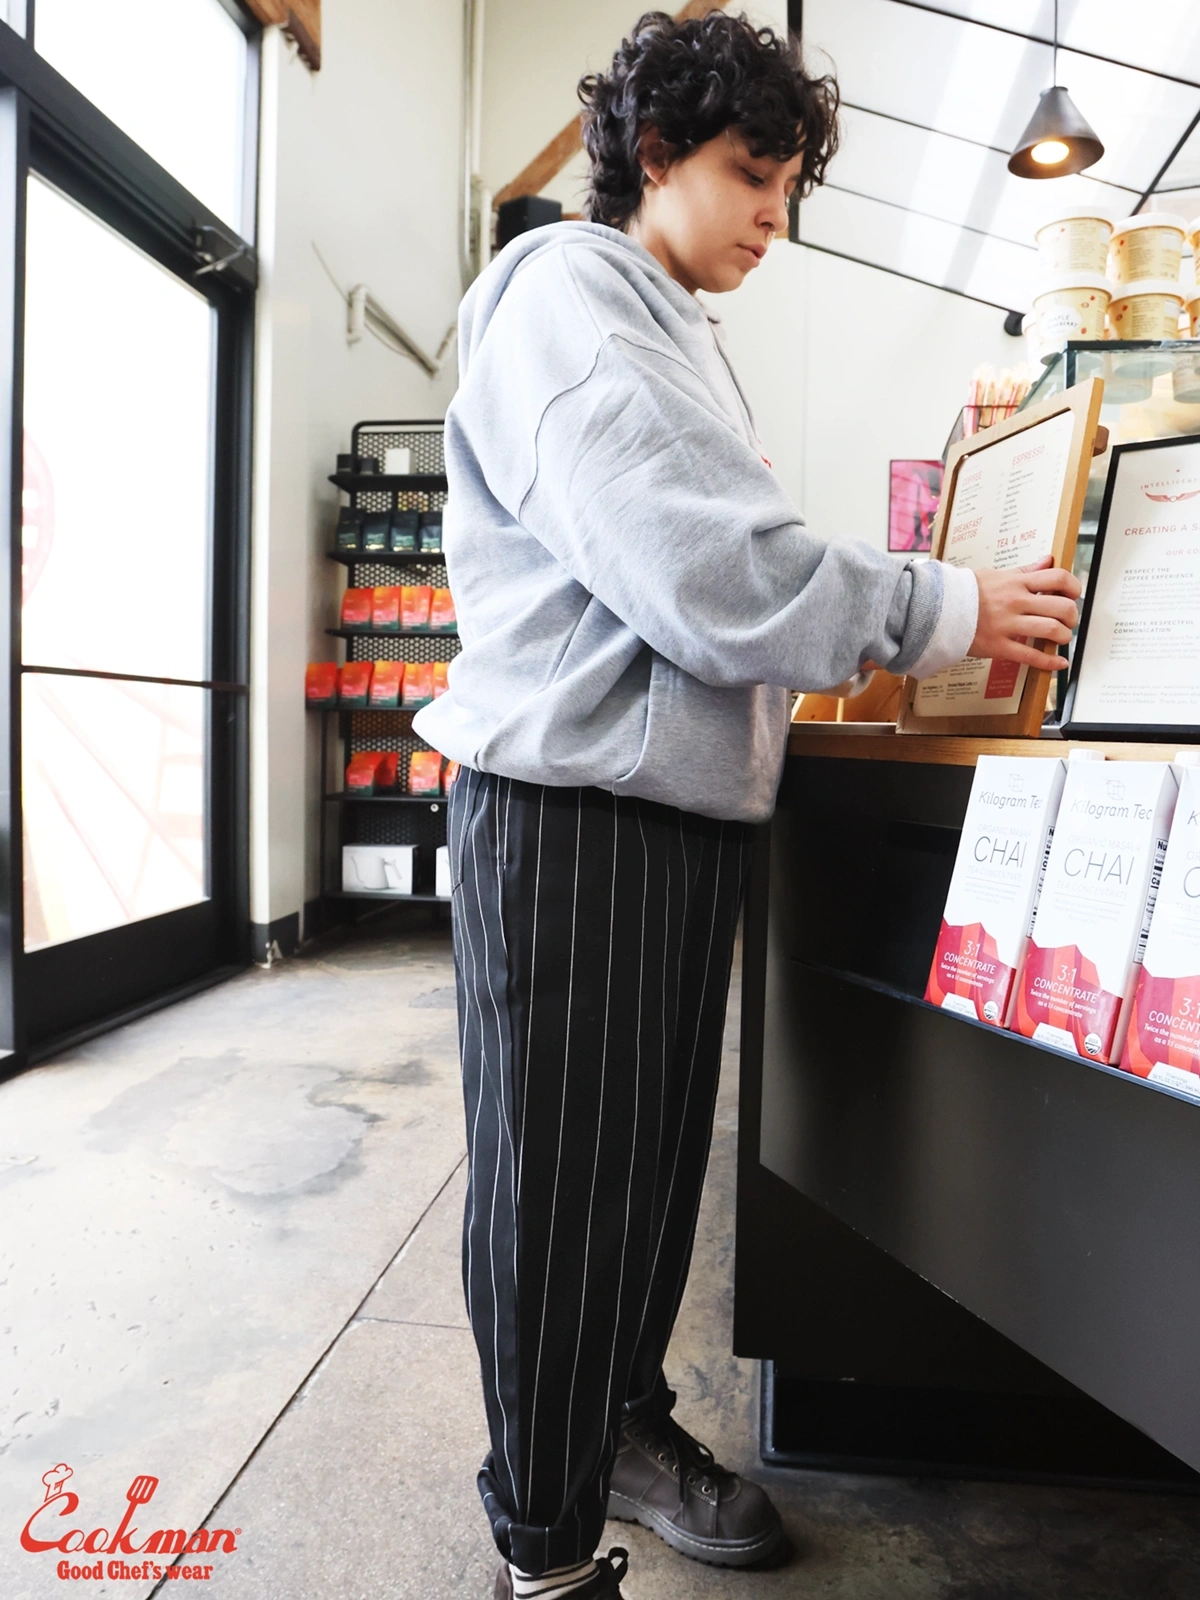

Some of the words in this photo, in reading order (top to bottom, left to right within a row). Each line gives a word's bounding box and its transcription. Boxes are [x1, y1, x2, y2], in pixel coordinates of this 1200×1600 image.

[1141, 478, 1200, 489] INTELLIGENT
[997, 538, 1009, 549] TEA
[1019, 529, 1037, 541] MORE
[1124, 524, 1177, 536] CREATING
[1180, 524, 1188, 532] A
[1151, 572, 1194, 580] EXPERIENCE
[978, 790, 1027, 810] Kilogram
[1070, 798, 1129, 820] Kilogram
[977, 823, 1009, 836] ORGANIC
[973, 835, 1028, 868] CHAI
[1068, 834, 1108, 849] ORGANIC
[1108, 839, 1142, 852] MASALA
[967, 864, 979, 875] TEA
[979, 866, 1023, 883] CONCENTRATE
[1063, 847, 1136, 886] CHAI
[1055, 879, 1070, 889] TEA
[1071, 882, 1129, 902] CONCENTRATE
[963, 940, 981, 957] 3:1
[943, 951, 997, 975] CONCENTRATE
[1057, 964, 1078, 984] 3:1
[1033, 977, 1099, 1004] CONCENTRATE
[1029, 988, 1042, 998] Twice
[1042, 992, 1050, 1000] the
[1050, 996, 1069, 1005] number
[1068, 1000, 1076, 1009] of
[1074, 1003, 1097, 1015] servings
[1053, 1005, 1083, 1019] concentrate
[1144, 1022, 1160, 1034] Twice
[1159, 1028, 1170, 1037] the
[1170, 1032, 1194, 1044] number
[1153, 1036, 1162, 1044] as
